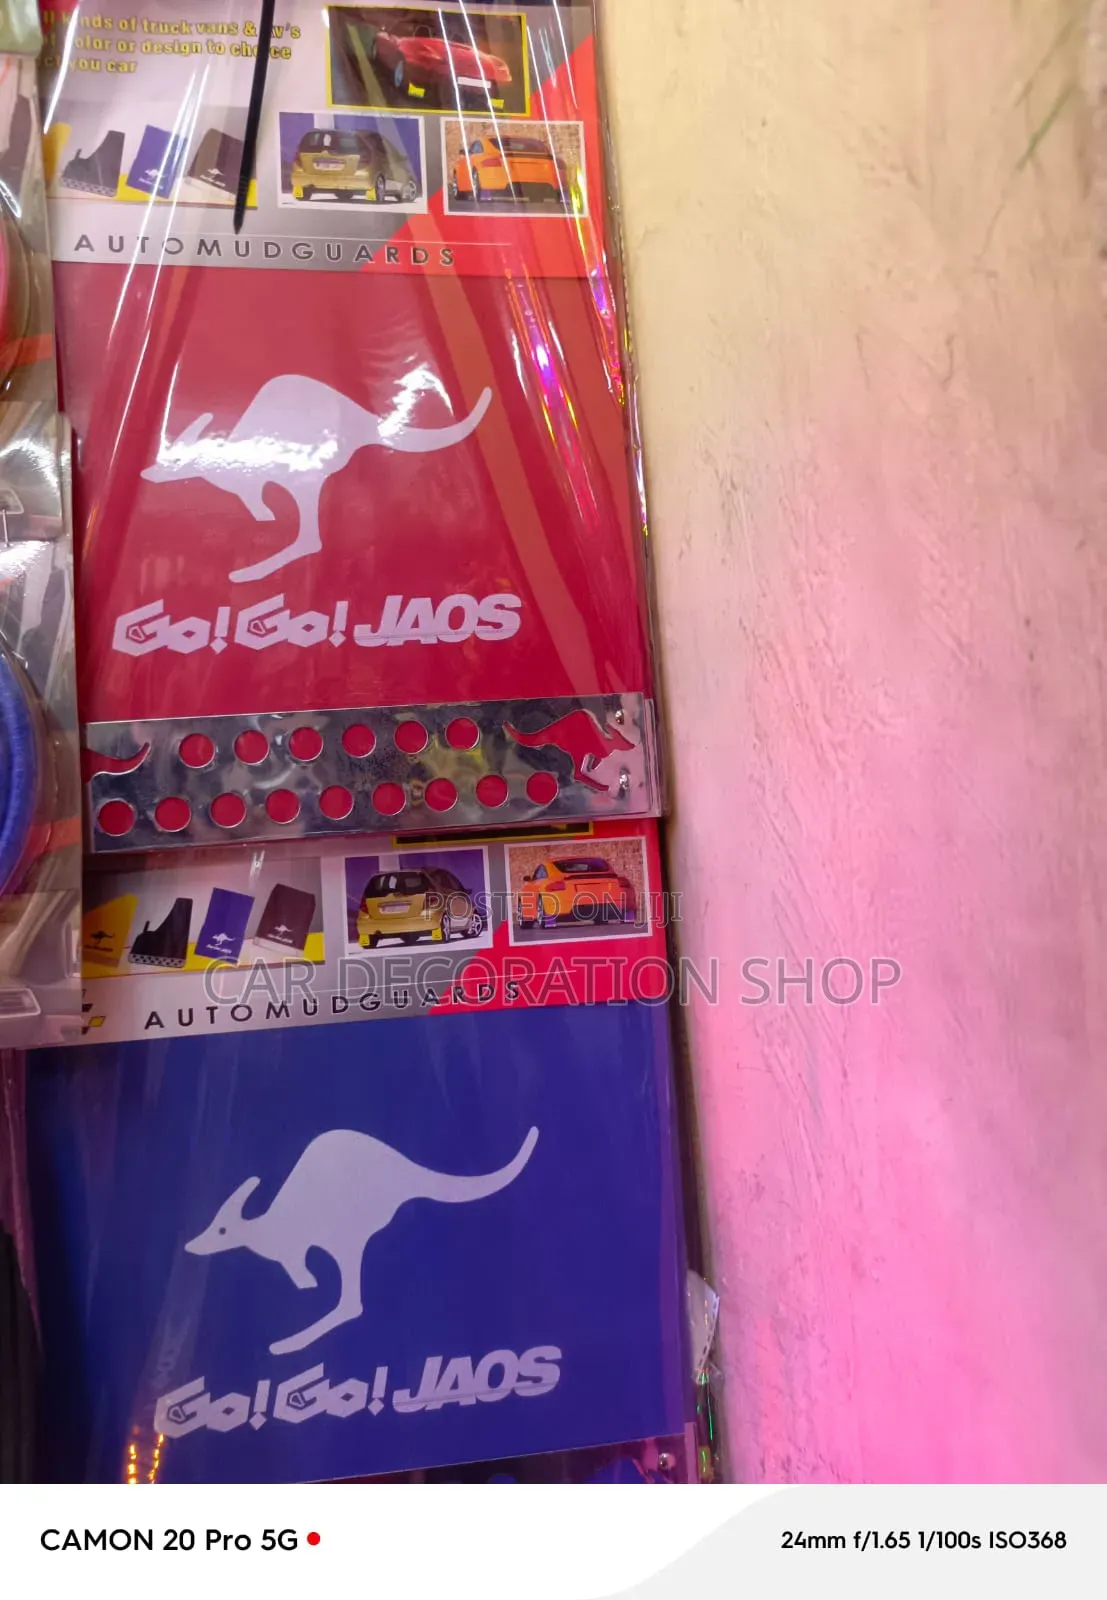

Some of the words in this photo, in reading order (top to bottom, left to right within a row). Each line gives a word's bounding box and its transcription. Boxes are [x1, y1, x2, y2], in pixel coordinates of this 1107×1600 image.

[62, 10, 113, 30] knds
[118, 16, 137, 32] of
[142, 18, 192, 35] truck
[196, 22, 239, 36] vans
[243, 20, 258, 37] &
[68, 34, 112, 50] olor
[117, 39, 136, 53] or
[141, 39, 203, 57] design
[206, 38, 226, 55] to
[106, 60, 138, 74] car
[74, 233, 456, 267] AUTOMUDGUARDS
[353, 593, 522, 648] JAOS
[144, 980, 520, 1031] AUTOMUDGUARDS
[393, 1345, 562, 1414] JAOS
